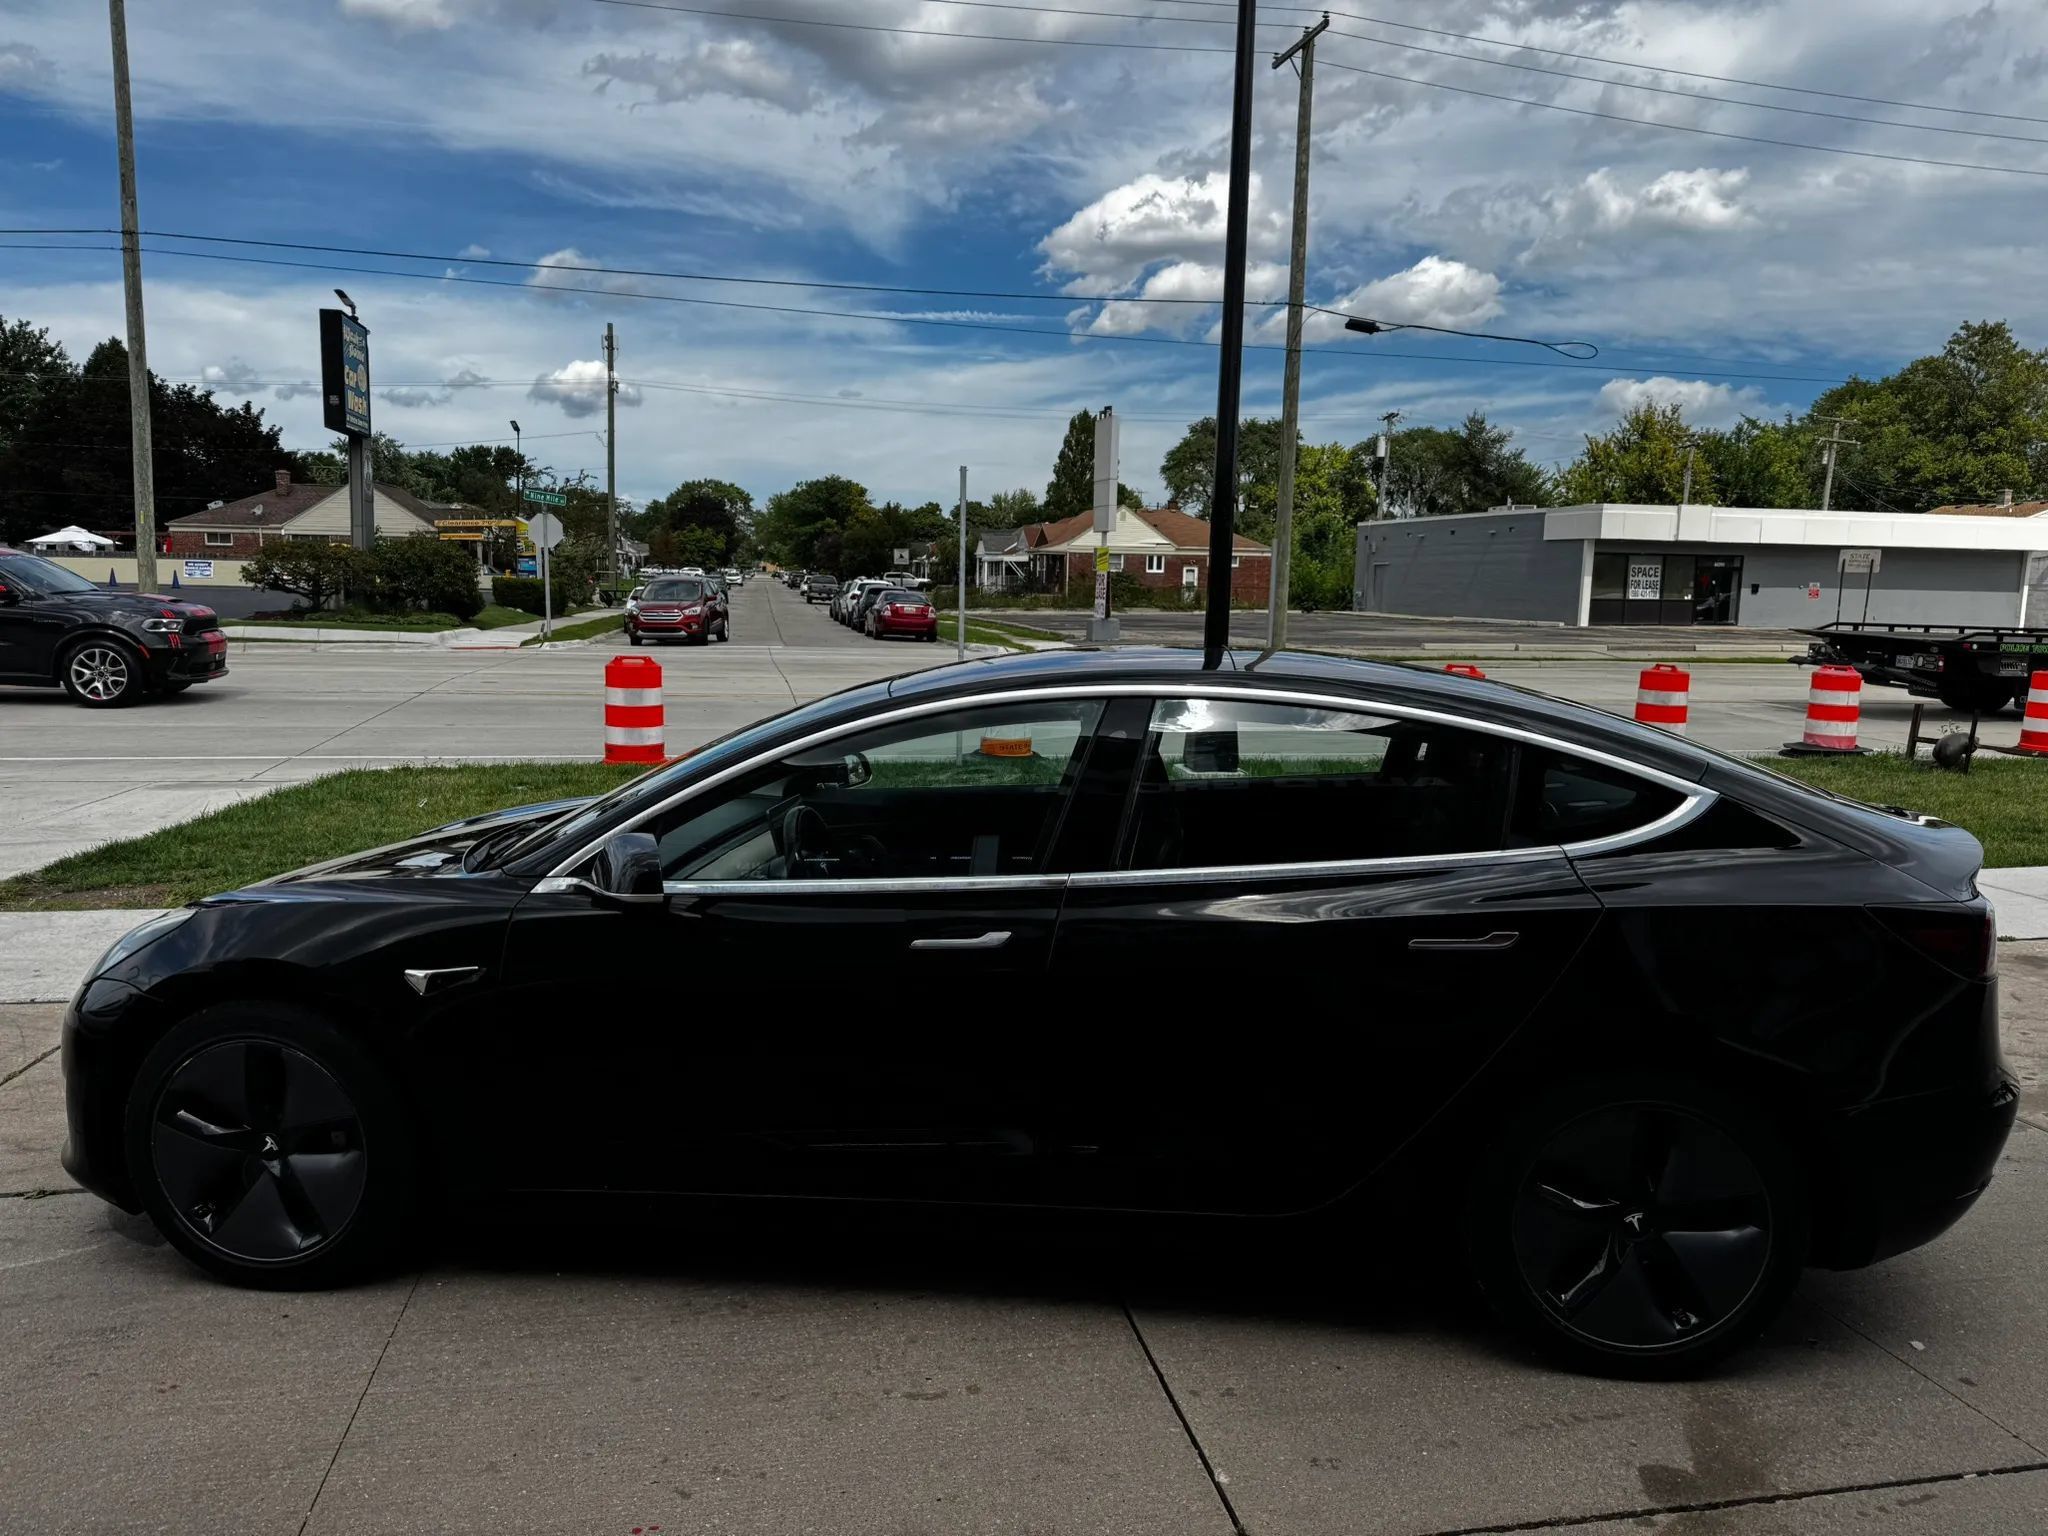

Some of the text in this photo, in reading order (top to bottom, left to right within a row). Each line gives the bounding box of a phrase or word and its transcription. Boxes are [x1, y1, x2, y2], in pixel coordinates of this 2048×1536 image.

[347, 388, 367, 417] Wash
[530, 491, 545, 500] Nine
[546, 494, 559, 503] Mile
[1631, 567, 1659, 578] SPACE
[1631, 579, 1659, 590] FOR LEASE
